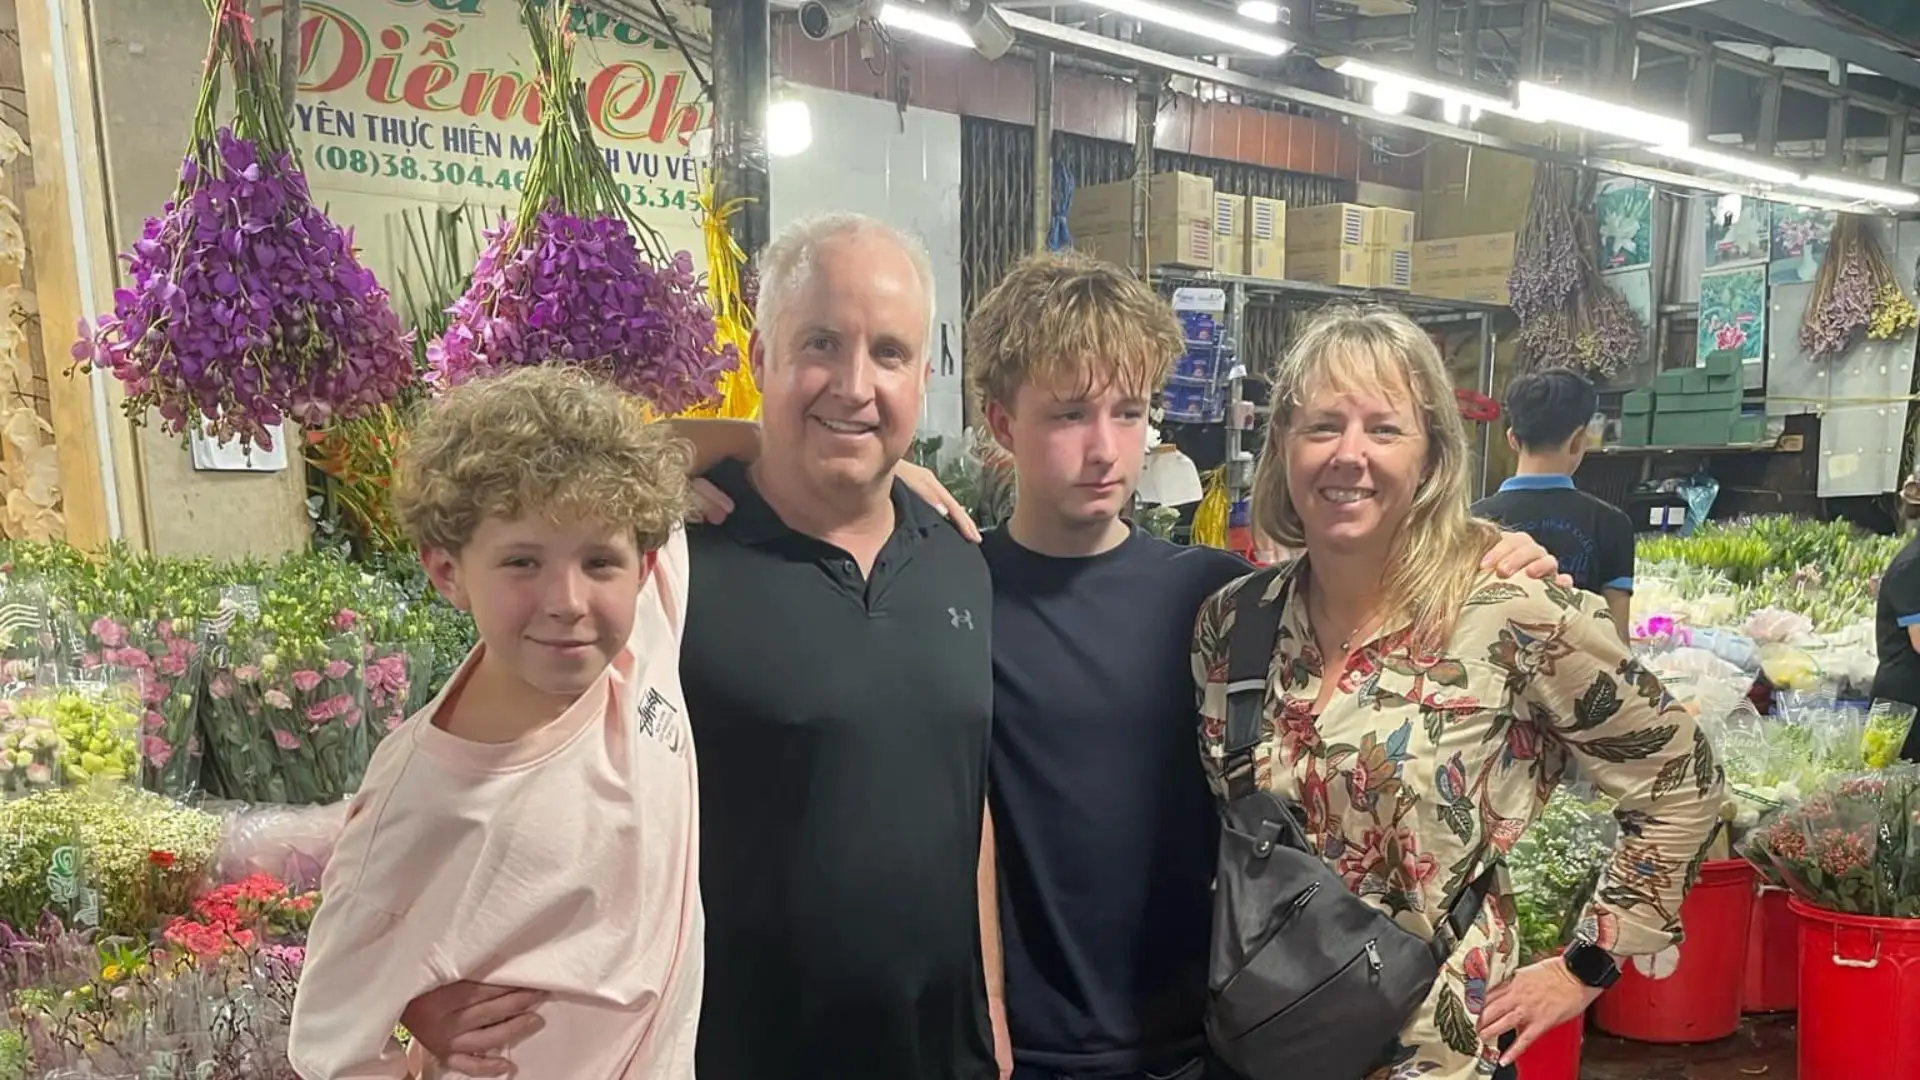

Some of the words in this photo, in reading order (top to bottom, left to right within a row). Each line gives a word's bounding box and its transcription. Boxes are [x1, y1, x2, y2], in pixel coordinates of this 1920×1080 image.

[289, 100, 355, 139] YÊN
[363, 115, 435, 155] THỰC
[442, 122, 502, 163] HIỆN
